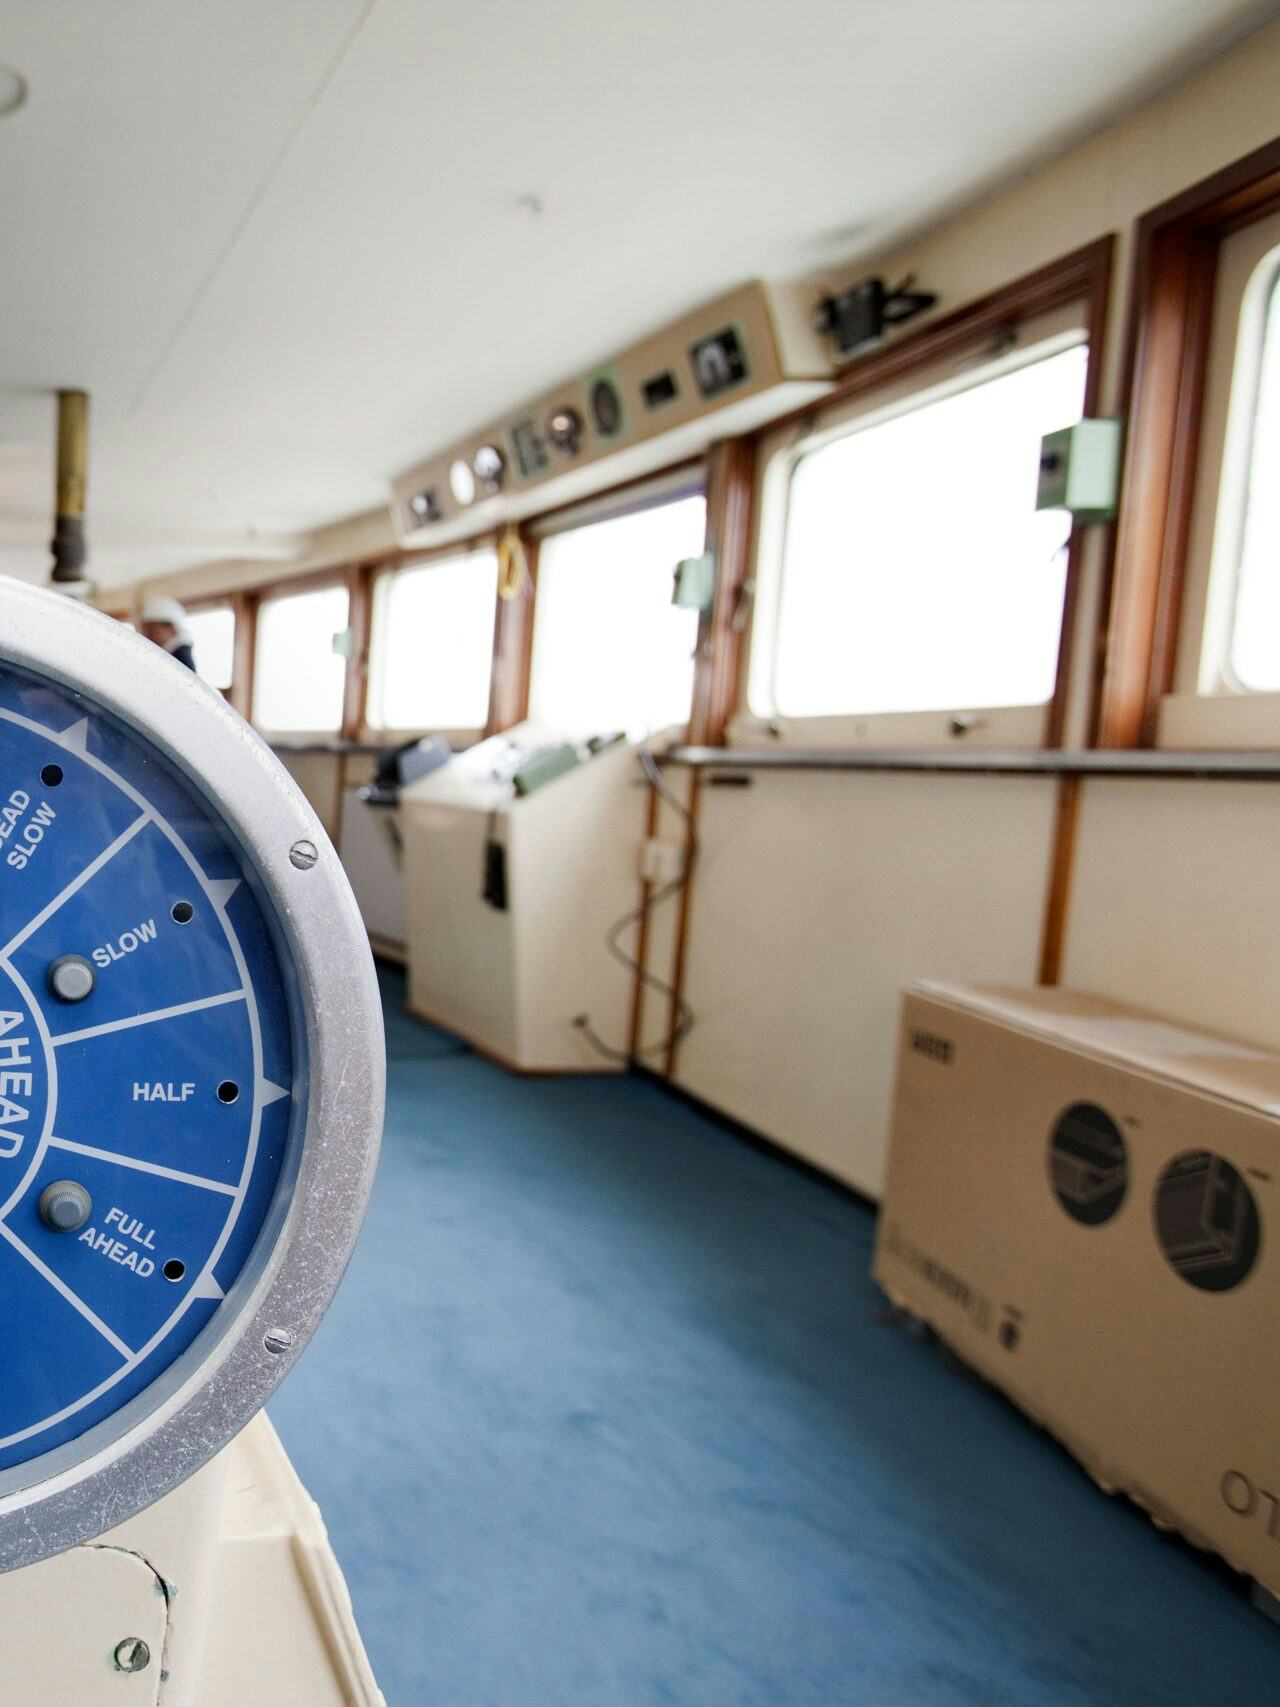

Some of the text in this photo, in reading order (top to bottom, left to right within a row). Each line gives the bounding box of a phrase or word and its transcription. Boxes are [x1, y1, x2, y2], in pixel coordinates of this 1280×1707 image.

[7, 801, 56, 870] SLOW
[91, 919, 158, 968] SLOW
[133, 1082, 196, 1101] HALF
[78, 1227, 155, 1279] AHEAD
[104, 1207, 156, 1250] FULL
